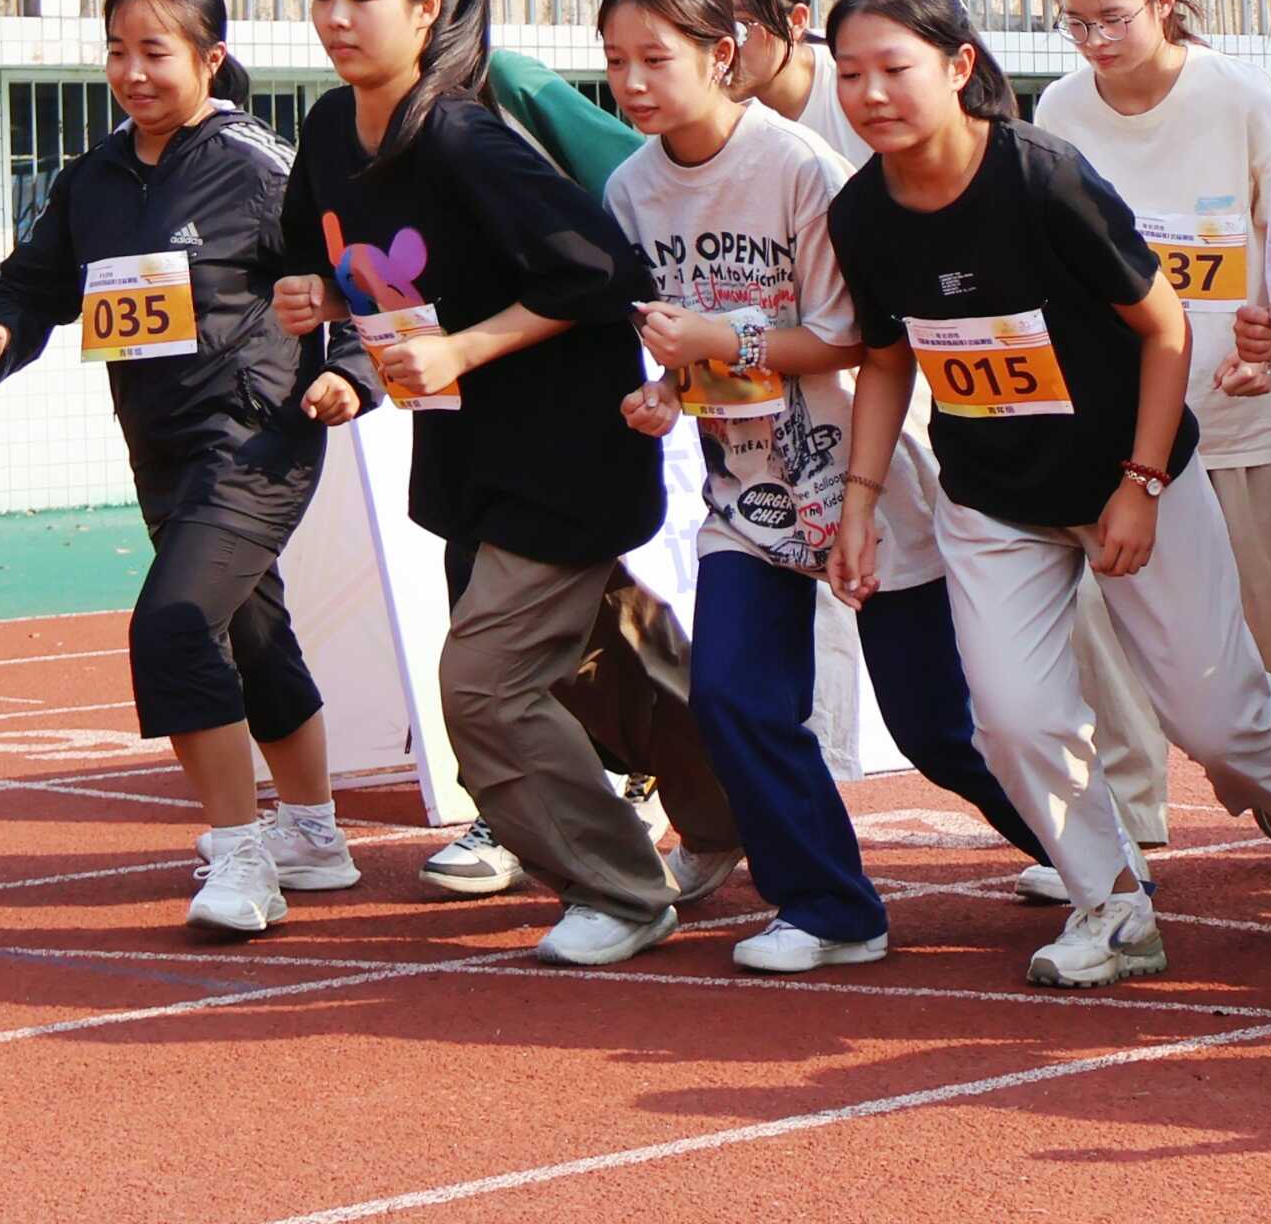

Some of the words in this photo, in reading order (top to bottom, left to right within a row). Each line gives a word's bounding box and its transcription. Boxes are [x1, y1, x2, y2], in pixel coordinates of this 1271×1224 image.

[170, 236, 203, 246] adidas
[1150, 250, 1224, 292] 37
[94, 294, 170, 339] 035
[943, 356, 1038, 397] 015
[749, 508, 786, 525] CHEF
